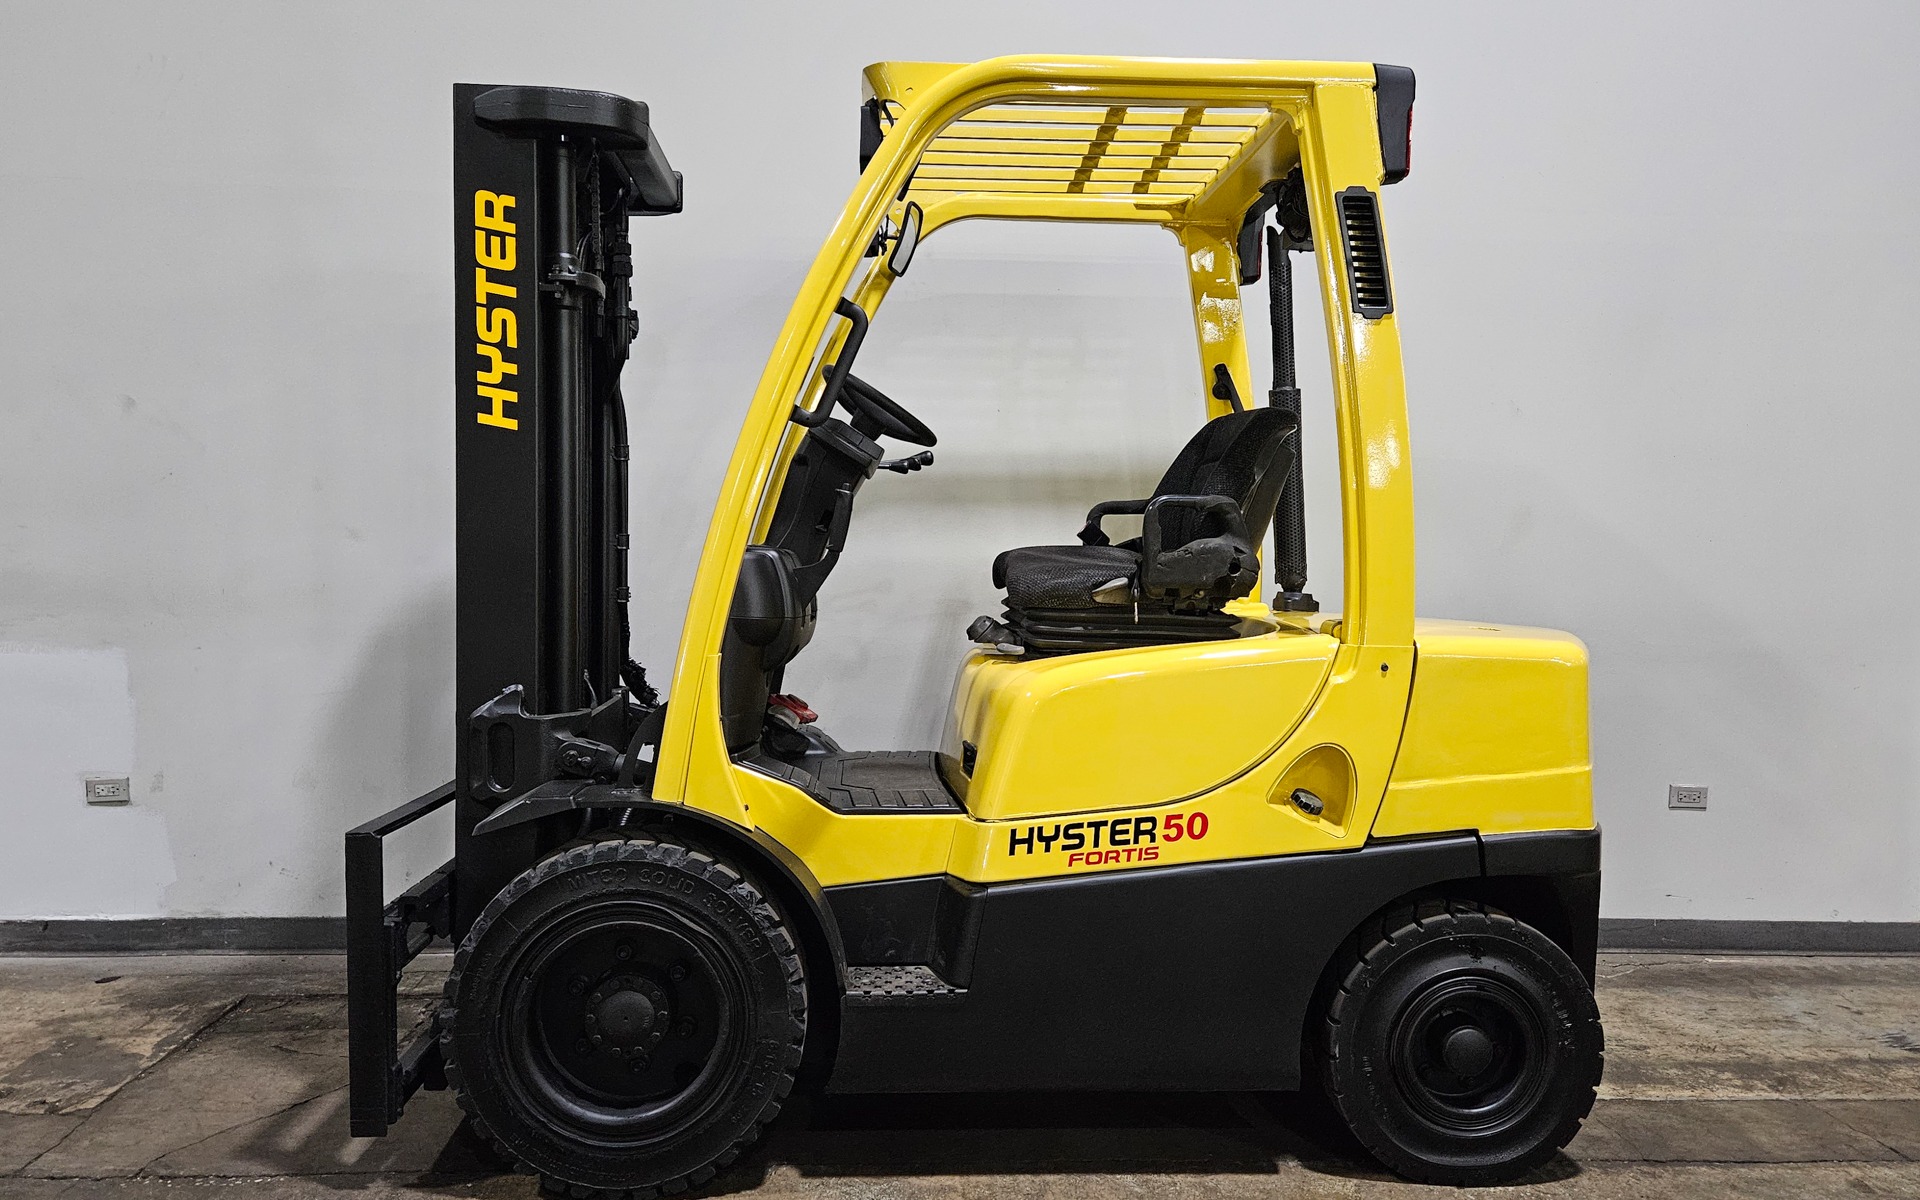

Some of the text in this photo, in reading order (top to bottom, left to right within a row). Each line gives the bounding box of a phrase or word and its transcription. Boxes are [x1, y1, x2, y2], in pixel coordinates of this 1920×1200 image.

[475, 189, 518, 430] HYSTER
[1009, 811, 1209, 857] HYSTER 50
[1068, 846, 1159, 867] FORTIS
